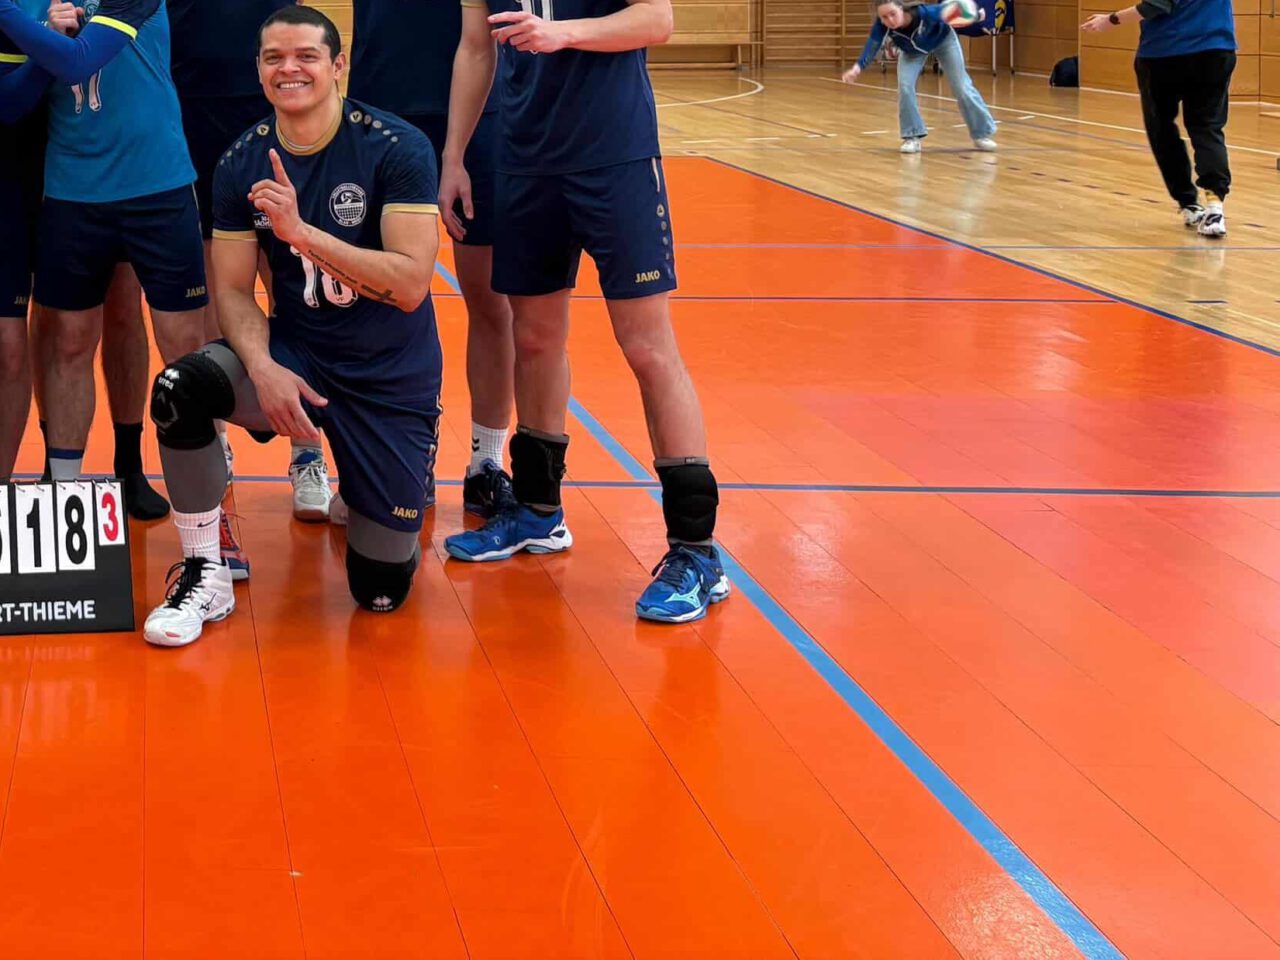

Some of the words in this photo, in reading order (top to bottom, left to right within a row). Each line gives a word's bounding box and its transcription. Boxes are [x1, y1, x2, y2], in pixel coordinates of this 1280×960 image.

[635, 270, 661, 283] JAKO
[101, 491, 119, 542] 3
[391, 505, 419, 519] JAKO
